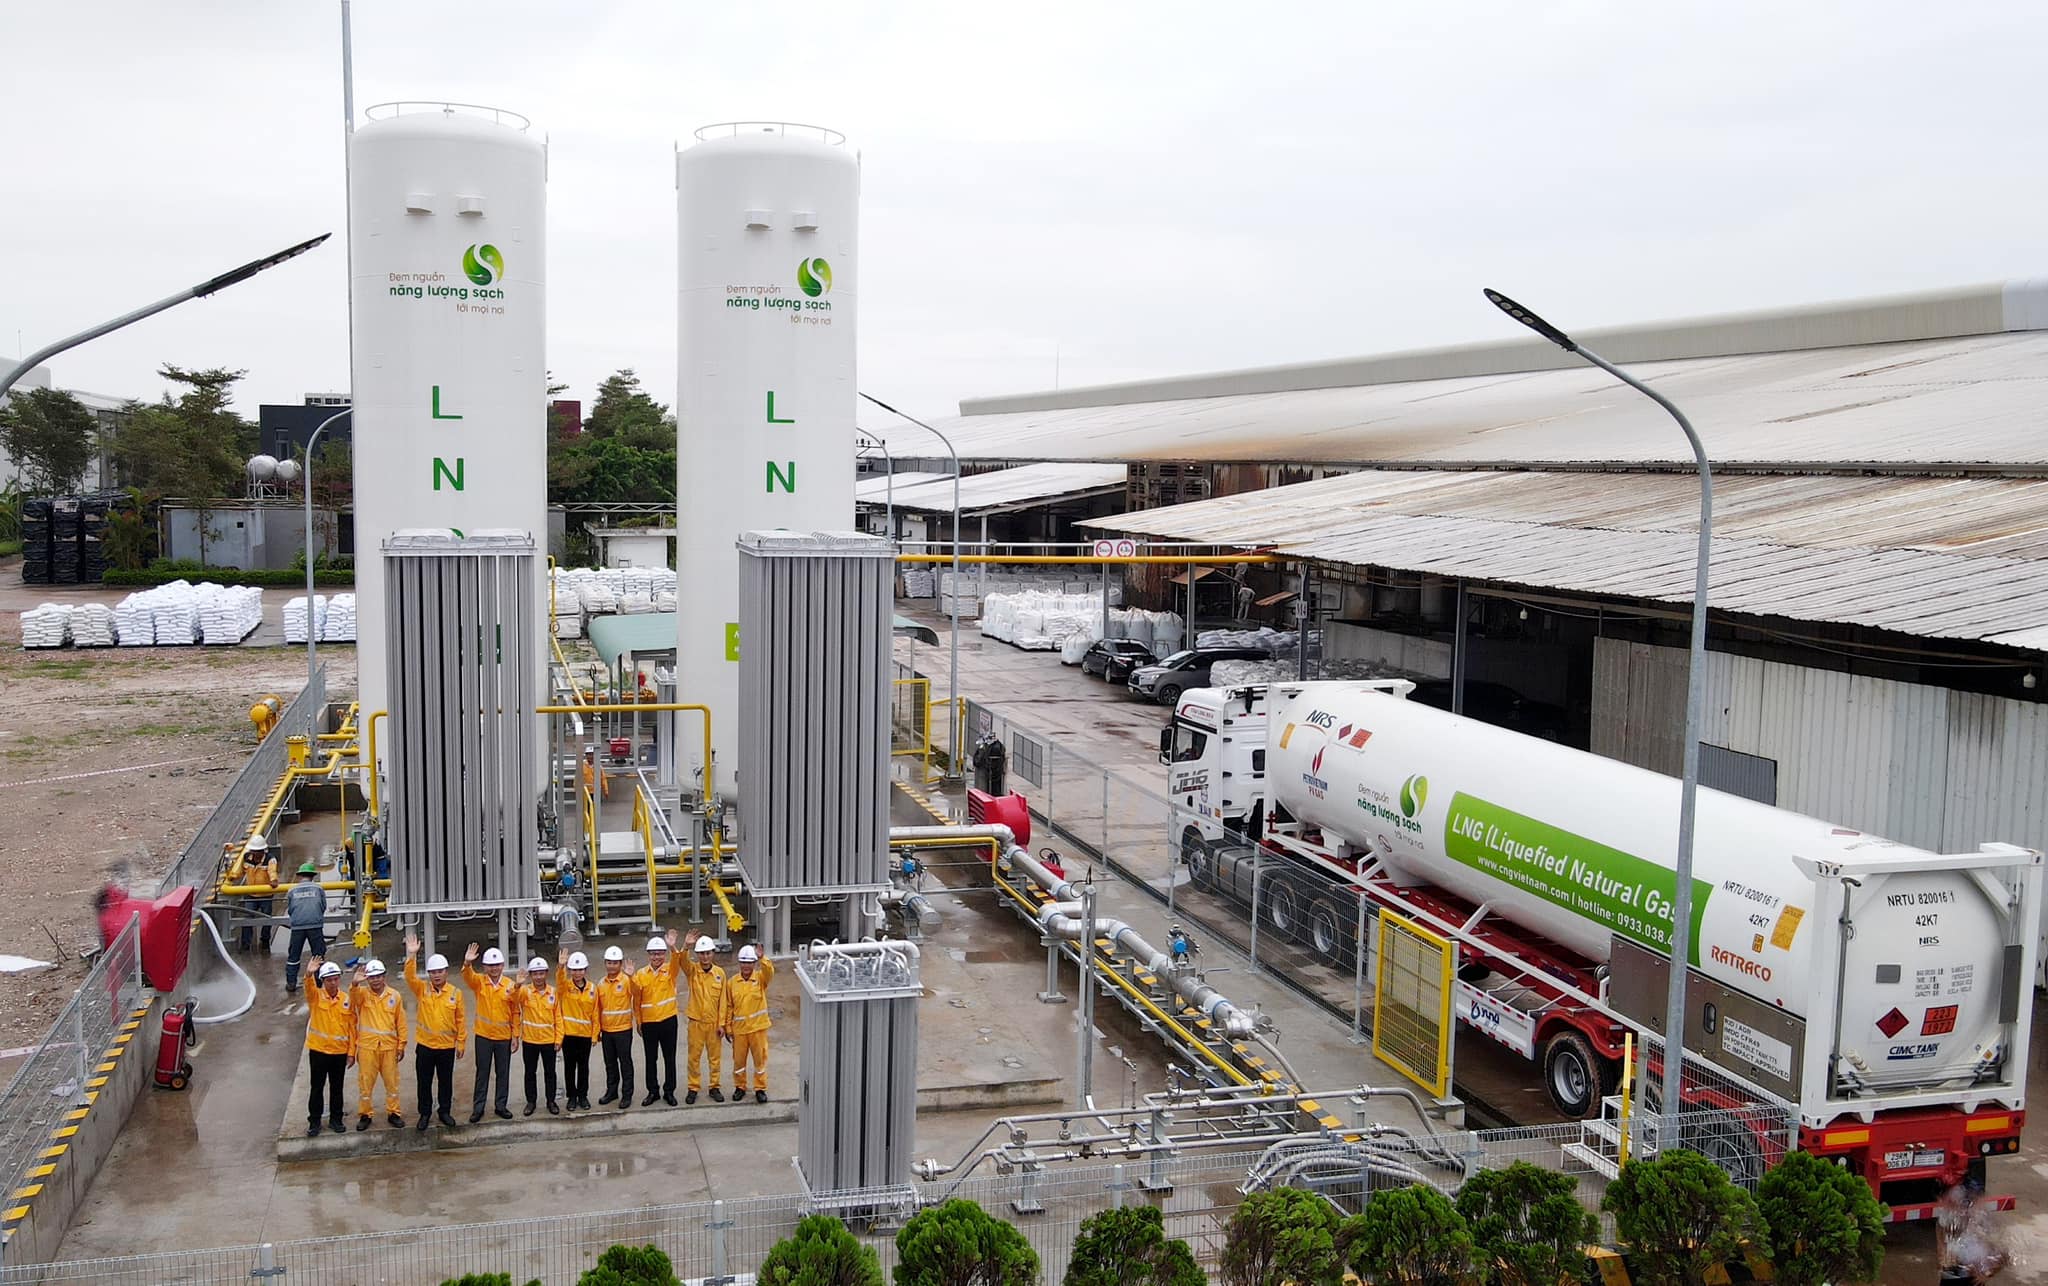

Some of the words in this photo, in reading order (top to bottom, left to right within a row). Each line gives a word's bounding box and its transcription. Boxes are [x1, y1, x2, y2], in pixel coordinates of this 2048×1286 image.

[389, 272, 410, 282] Đem
[428, 285, 468, 300] lượng
[472, 287, 504, 301] sạch
[764, 296, 801, 311] lượng
[804, 299, 831, 312] sạch
[1306, 709, 1338, 729] NRS
[1378, 804, 1400, 828] lượng
[1402, 817, 1422, 834] sạch
[1452, 813, 1485, 842] LNG
[1485, 824, 1568, 876] (Liquefied
[1568, 859, 1643, 907] Natural
[1477, 854, 1569, 901] www.cngvietnam.com
[1577, 898, 1615, 922] hotline:
[1722, 880, 1745, 895] NRTU
[1887, 893, 1915, 907] NRTU
[1918, 892, 1948, 905] 820016
[1749, 913, 1770, 928] 42K7
[1915, 914, 1938, 926] 42K7
[1919, 936, 1939, 945] NRS
[1711, 944, 1772, 982] RATRACO
[1889, 1044, 1916, 1055] CIMC
[1916, 1043, 1940, 1053] TANK
[1732, 1046, 1754, 1061] IMPACT
[1754, 1058, 1789, 1079] APPROVED
